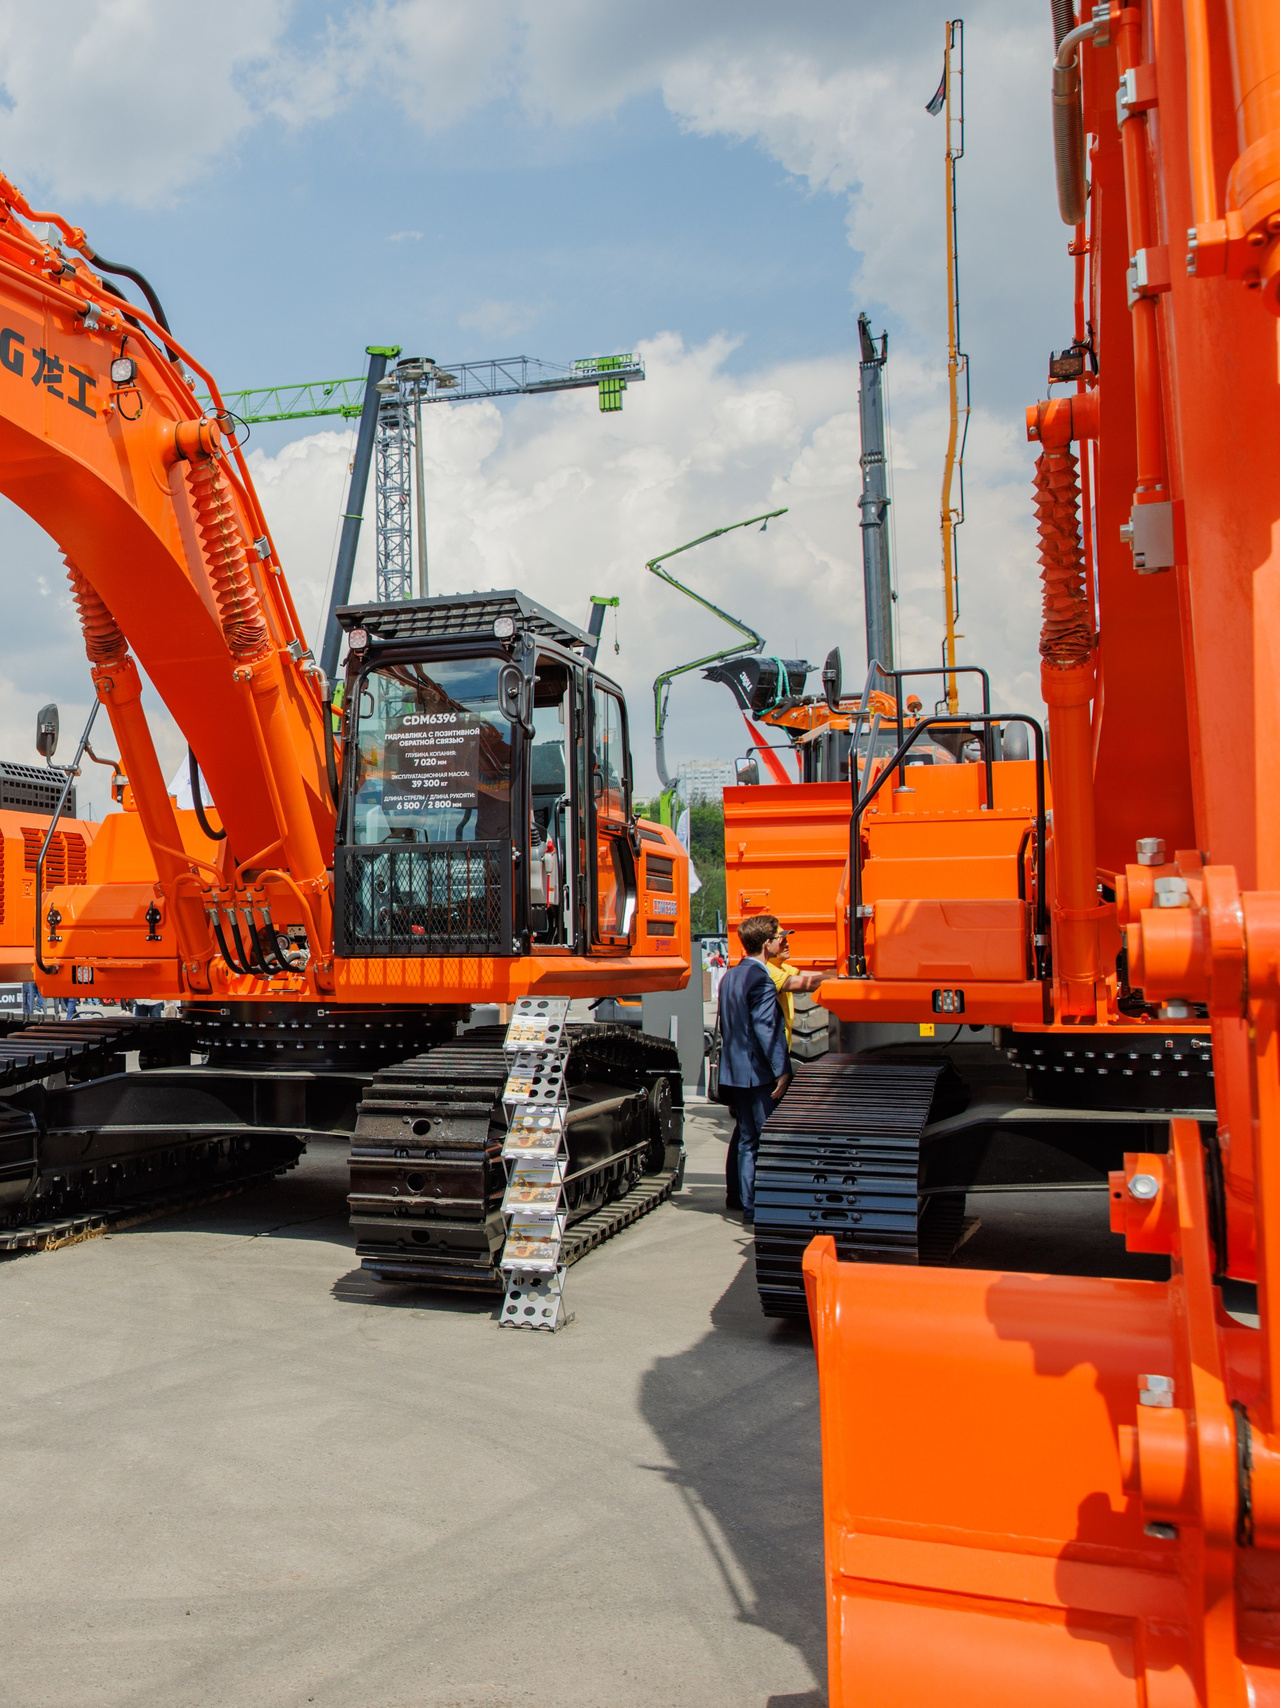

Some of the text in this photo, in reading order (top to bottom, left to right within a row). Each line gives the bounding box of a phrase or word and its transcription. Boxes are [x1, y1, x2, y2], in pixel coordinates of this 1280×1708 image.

[32, 346, 97, 419] 龙工
[403, 713, 457, 726] CDM6396
[385, 732, 427, 740] ГИДРАВЛИКА
[435, 728, 480, 737] ПОЗИТИВНОЙ
[399, 738, 434, 746] ОБРАТНОЙ
[420, 758, 436, 766] 020
[391, 772, 447, 780] ЭКСПЛУАТАЦИОННАЯ
[412, 780, 422, 788] 39
[423, 779, 440, 787] 300
[434, 800, 451, 808] 800
